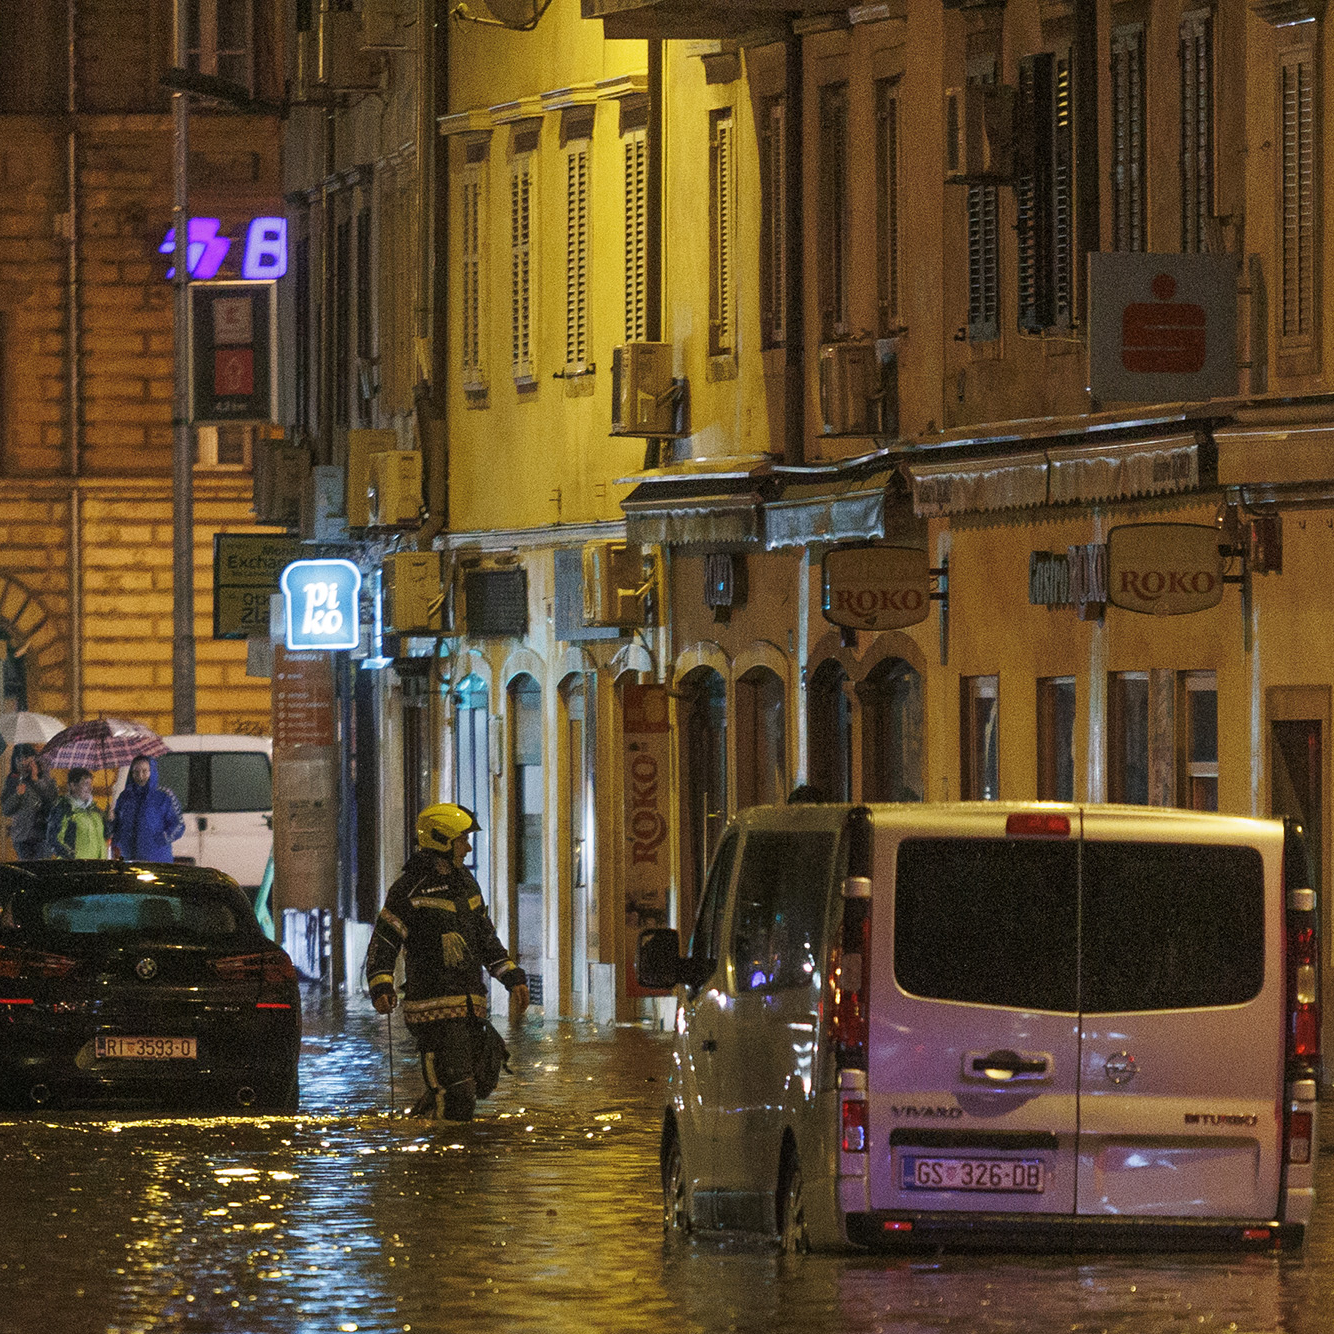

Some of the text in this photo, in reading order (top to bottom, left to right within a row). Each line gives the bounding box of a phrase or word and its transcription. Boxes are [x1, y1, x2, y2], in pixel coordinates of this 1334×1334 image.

[228, 555, 286, 569] Exchan
[1120, 570, 1217, 601] ROKO
[835, 589, 924, 618] ROKO
[631, 754, 666, 866] ROKO
[107, 1039, 123, 1057] RI
[918, 1161, 1040, 1187] GS 326-DB
